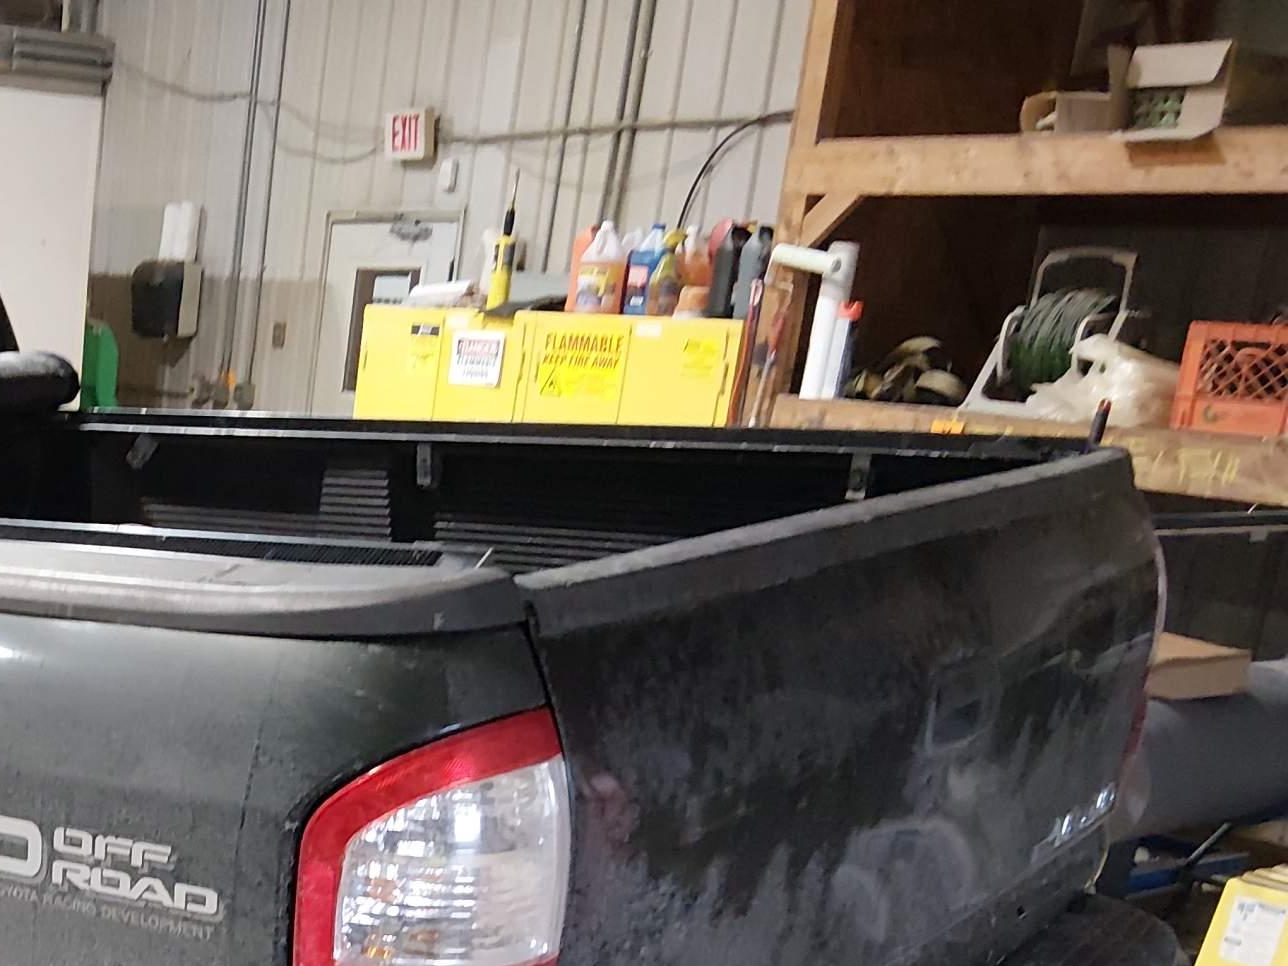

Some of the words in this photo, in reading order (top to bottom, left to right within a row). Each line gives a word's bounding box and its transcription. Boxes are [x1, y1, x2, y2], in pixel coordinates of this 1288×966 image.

[391, 113, 420, 152] EXIT
[545, 332, 624, 353] FLAMMABLE
[591, 355, 620, 369] AWAY
[53, 827, 173, 867] OFF
[51, 859, 218, 914] ROAD
[100, 906, 213, 941] DEVELOPMENT
